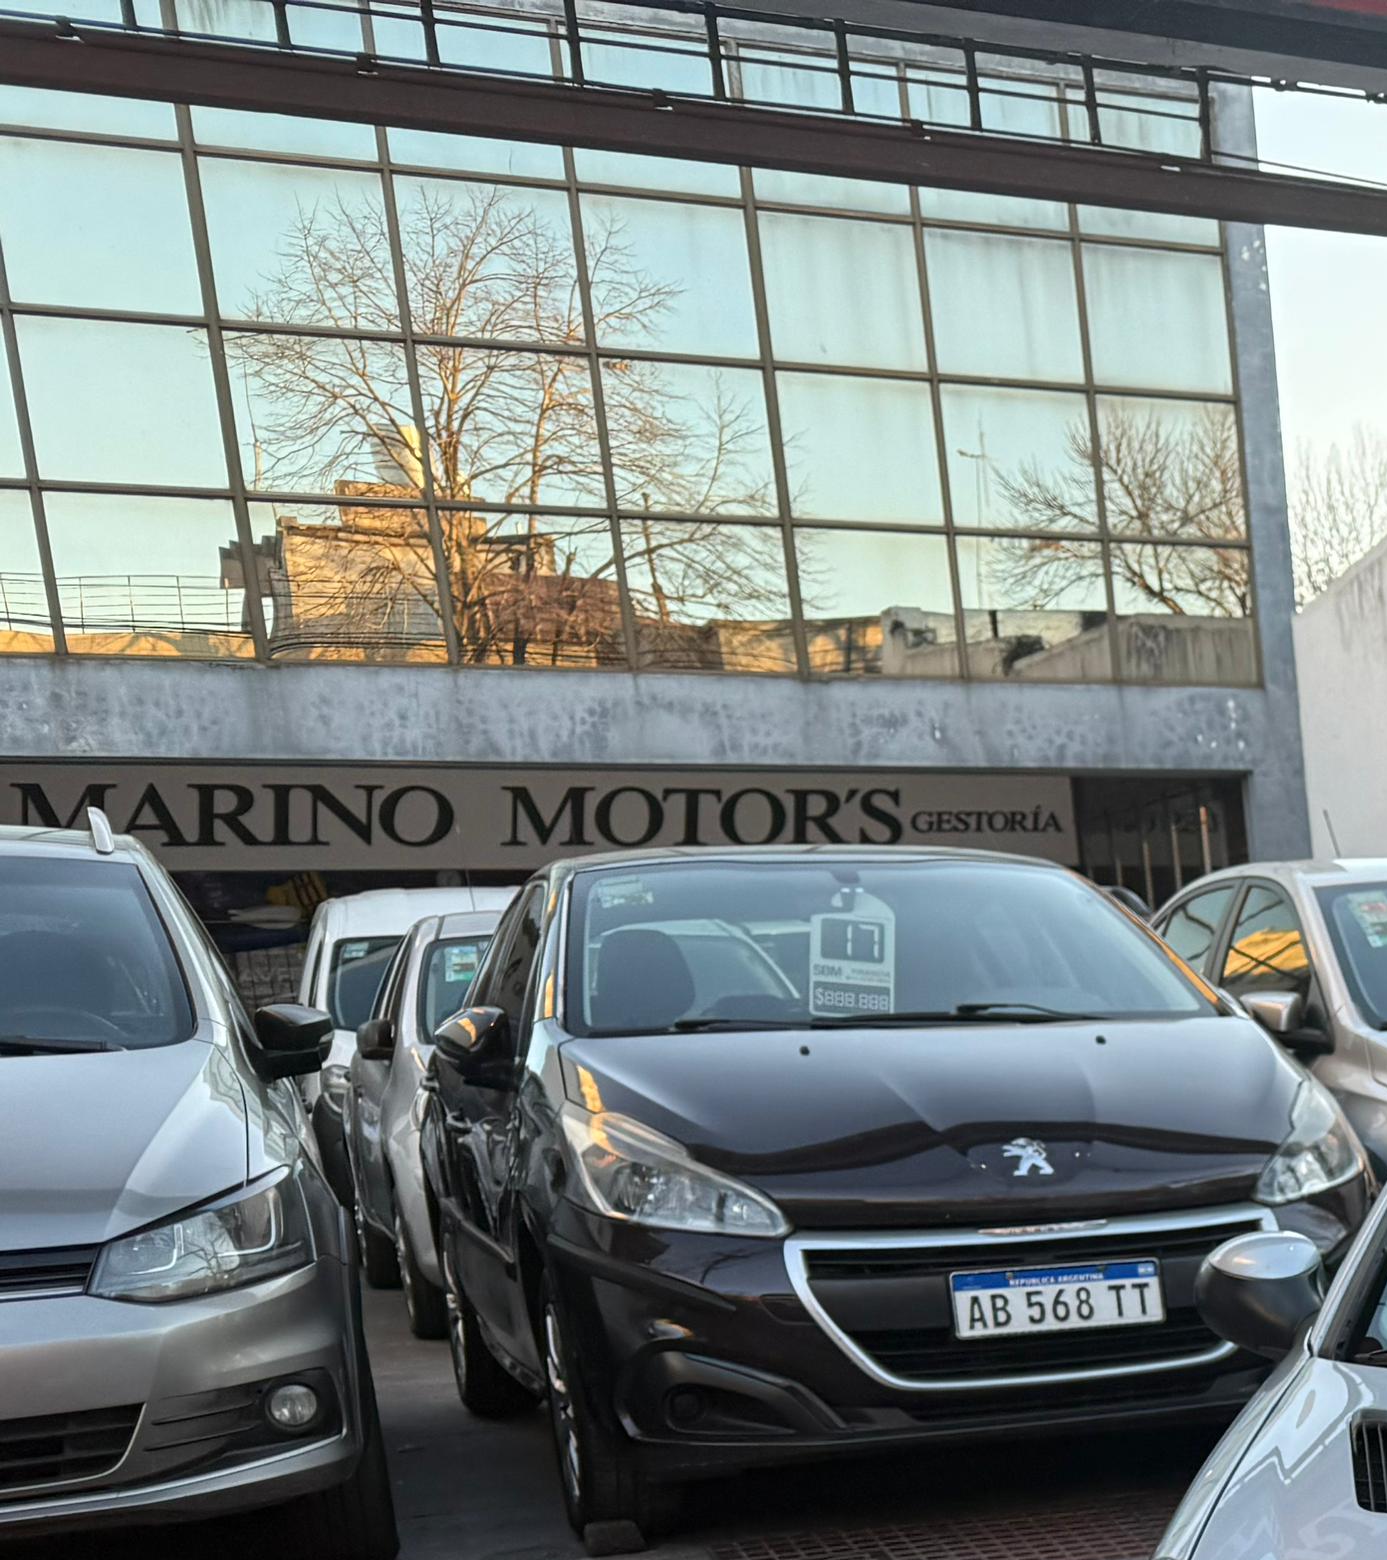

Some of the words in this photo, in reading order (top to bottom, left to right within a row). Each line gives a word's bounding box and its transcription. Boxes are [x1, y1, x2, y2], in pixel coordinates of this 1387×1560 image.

[9, 782, 455, 848] MARINO
[502, 786, 901, 847] MOTOR'S
[911, 804, 1063, 834] GESTORÍA
[969, 1293, 1012, 1330] AB
[1026, 1287, 1095, 1324] 568
[1107, 1283, 1150, 1318] TT
